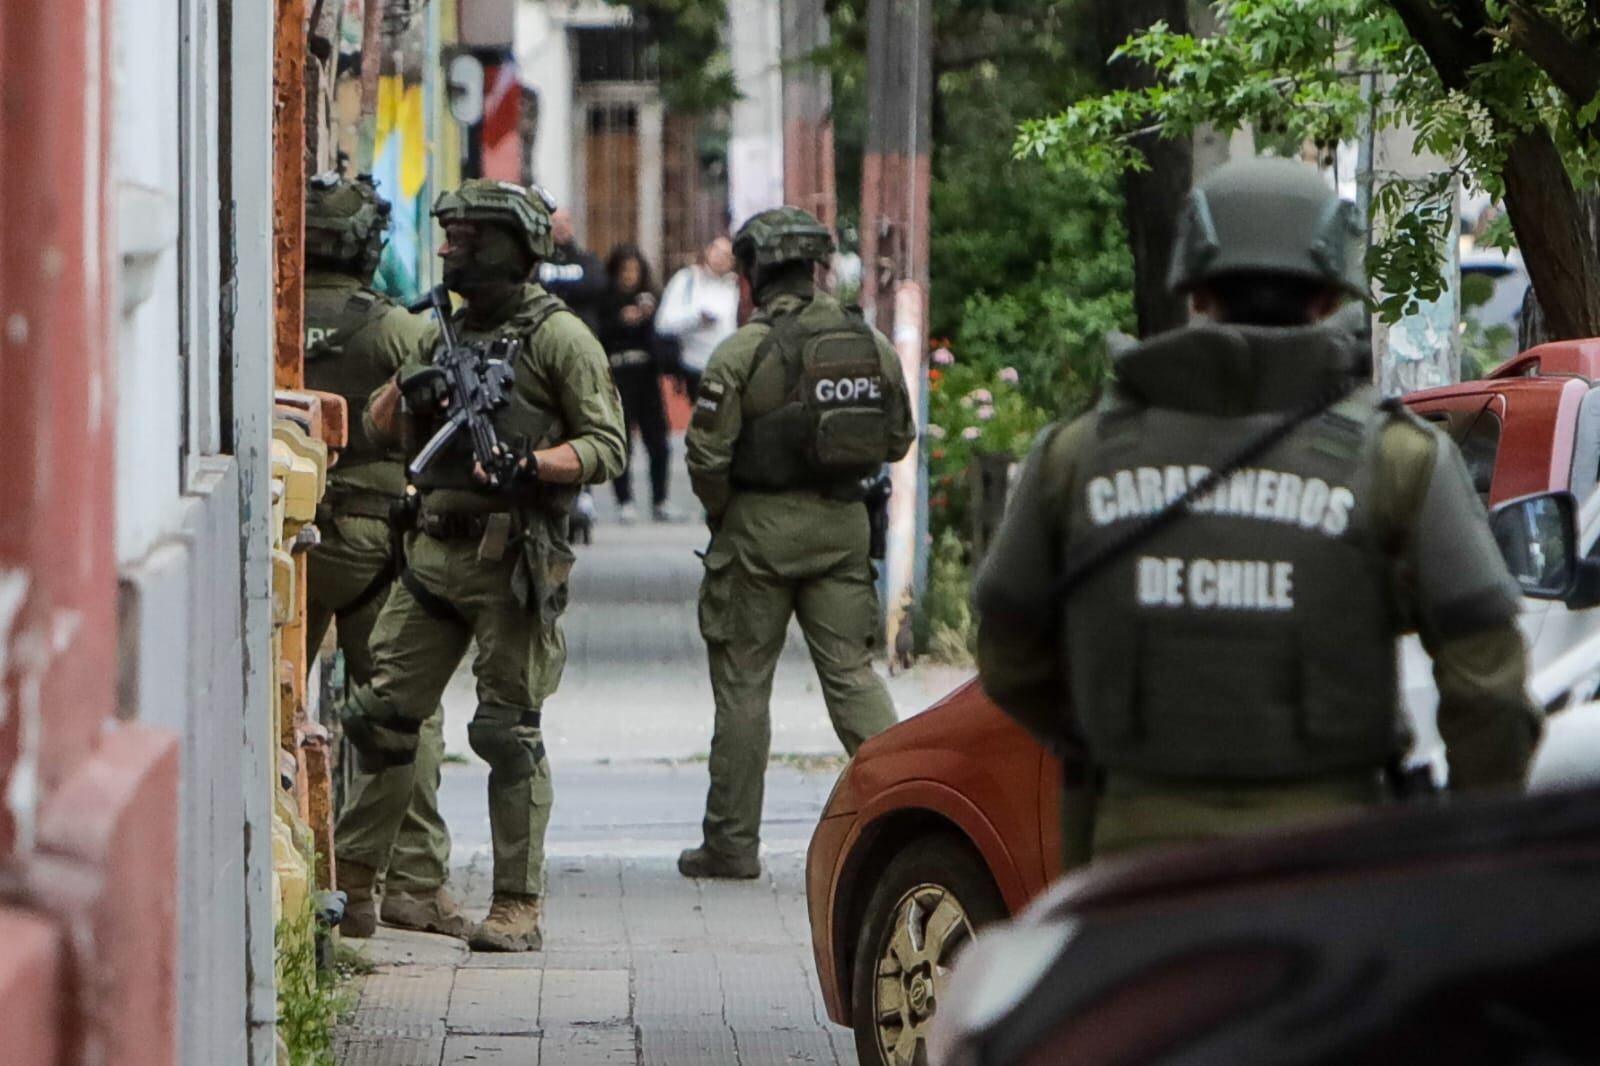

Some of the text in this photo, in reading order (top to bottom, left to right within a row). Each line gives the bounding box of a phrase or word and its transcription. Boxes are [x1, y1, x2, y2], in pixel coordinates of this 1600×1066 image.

[815, 376, 882, 401] GOPE
[1136, 556, 1294, 610] DE CHILE
